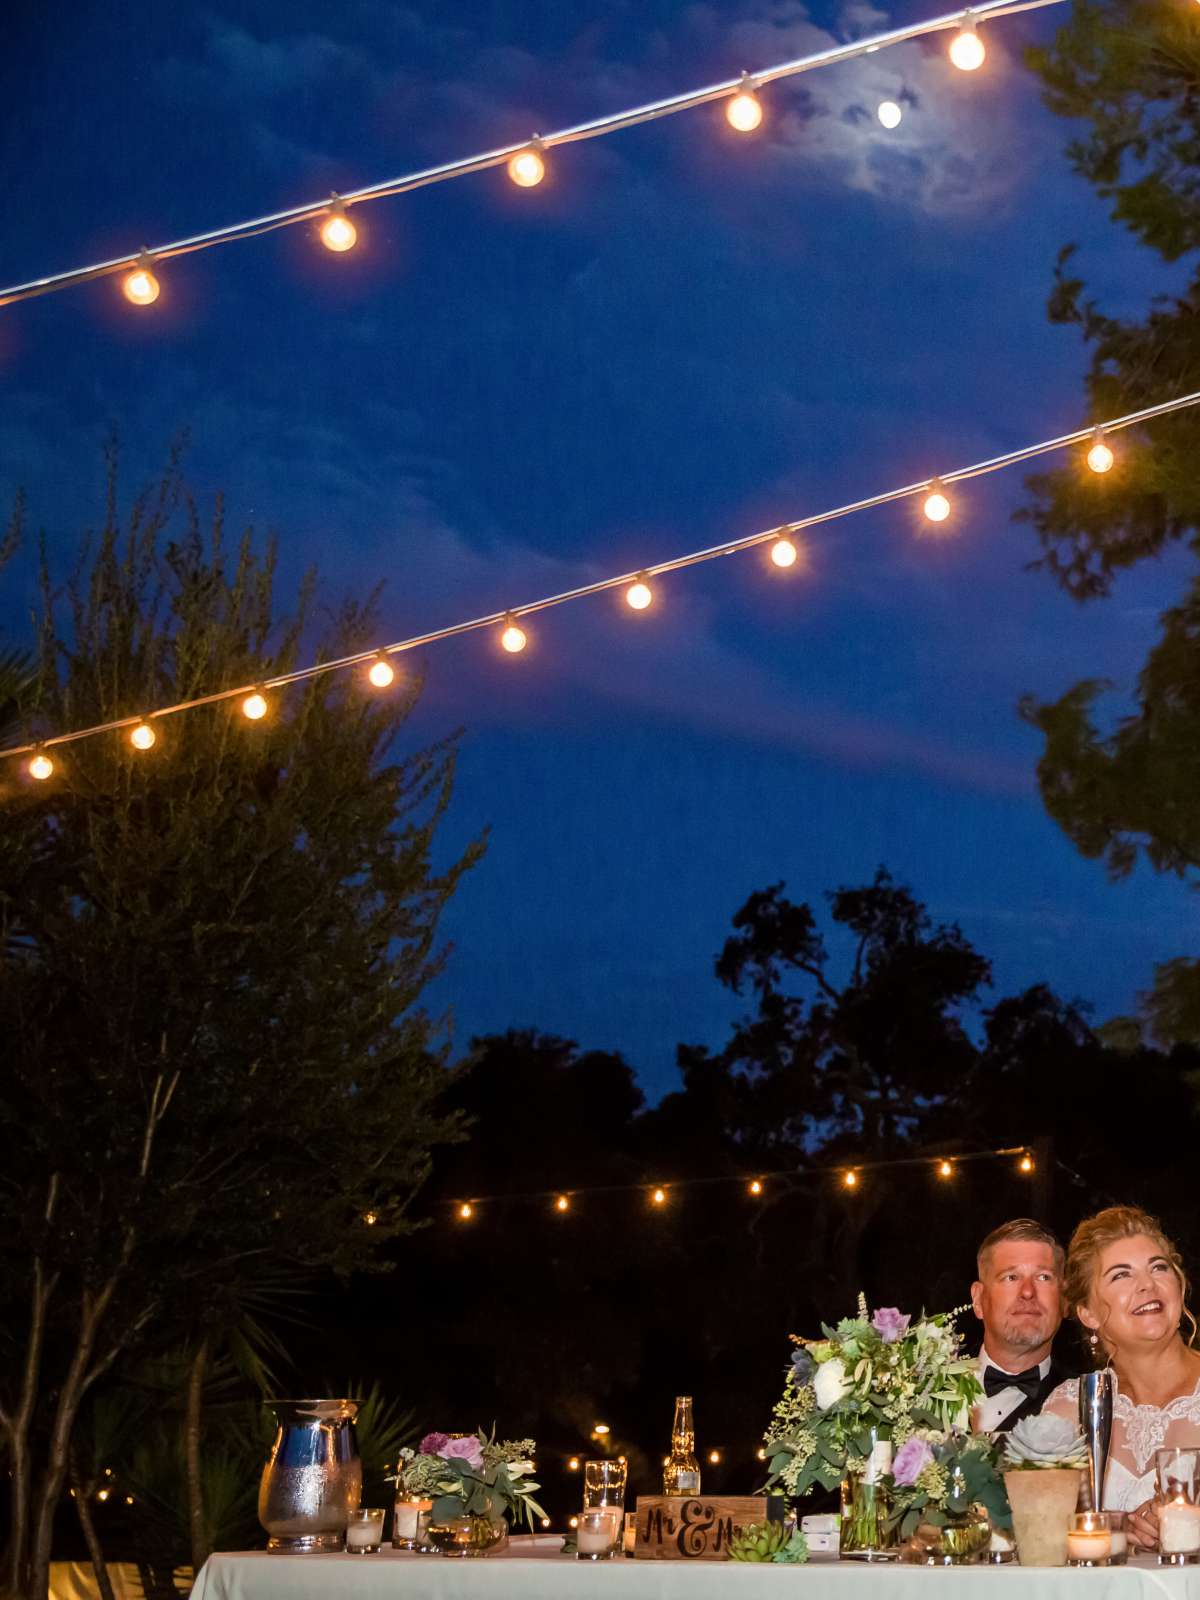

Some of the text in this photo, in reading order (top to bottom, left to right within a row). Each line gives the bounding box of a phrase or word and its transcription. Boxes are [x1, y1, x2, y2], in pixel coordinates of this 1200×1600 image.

[642, 1499, 744, 1558] Mr & Mr
